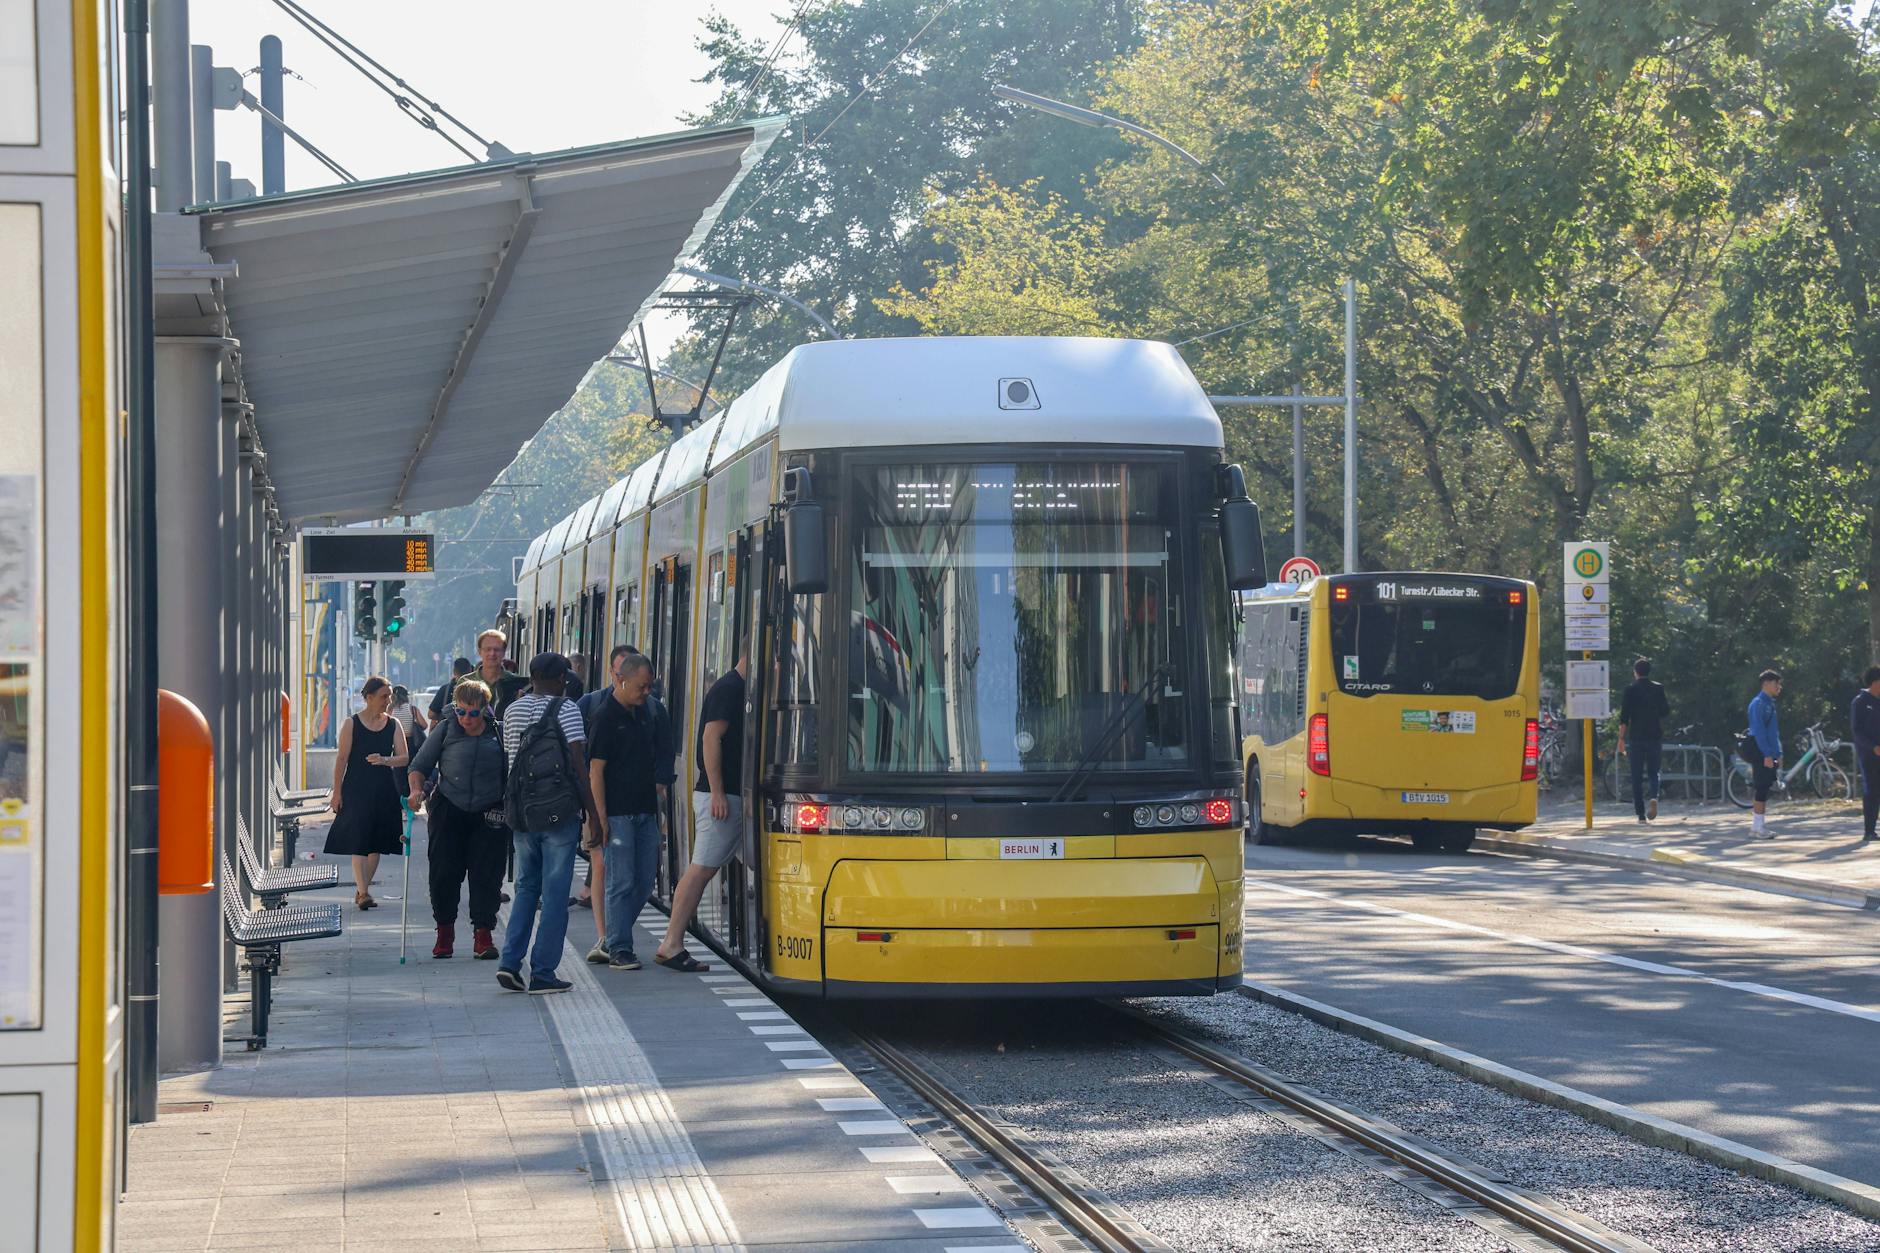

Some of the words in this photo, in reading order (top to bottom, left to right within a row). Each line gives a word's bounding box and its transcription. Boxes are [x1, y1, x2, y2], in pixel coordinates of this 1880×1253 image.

[1288, 568, 1312, 584] 30
[1376, 582, 1396, 599] 101
[1465, 587, 1480, 598] Str.
[1344, 683, 1392, 691] CITARO
[1503, 709, 1521, 718] 1015
[1004, 845, 1040, 855] BERLIN
[776, 934, 814, 961] B-9007
